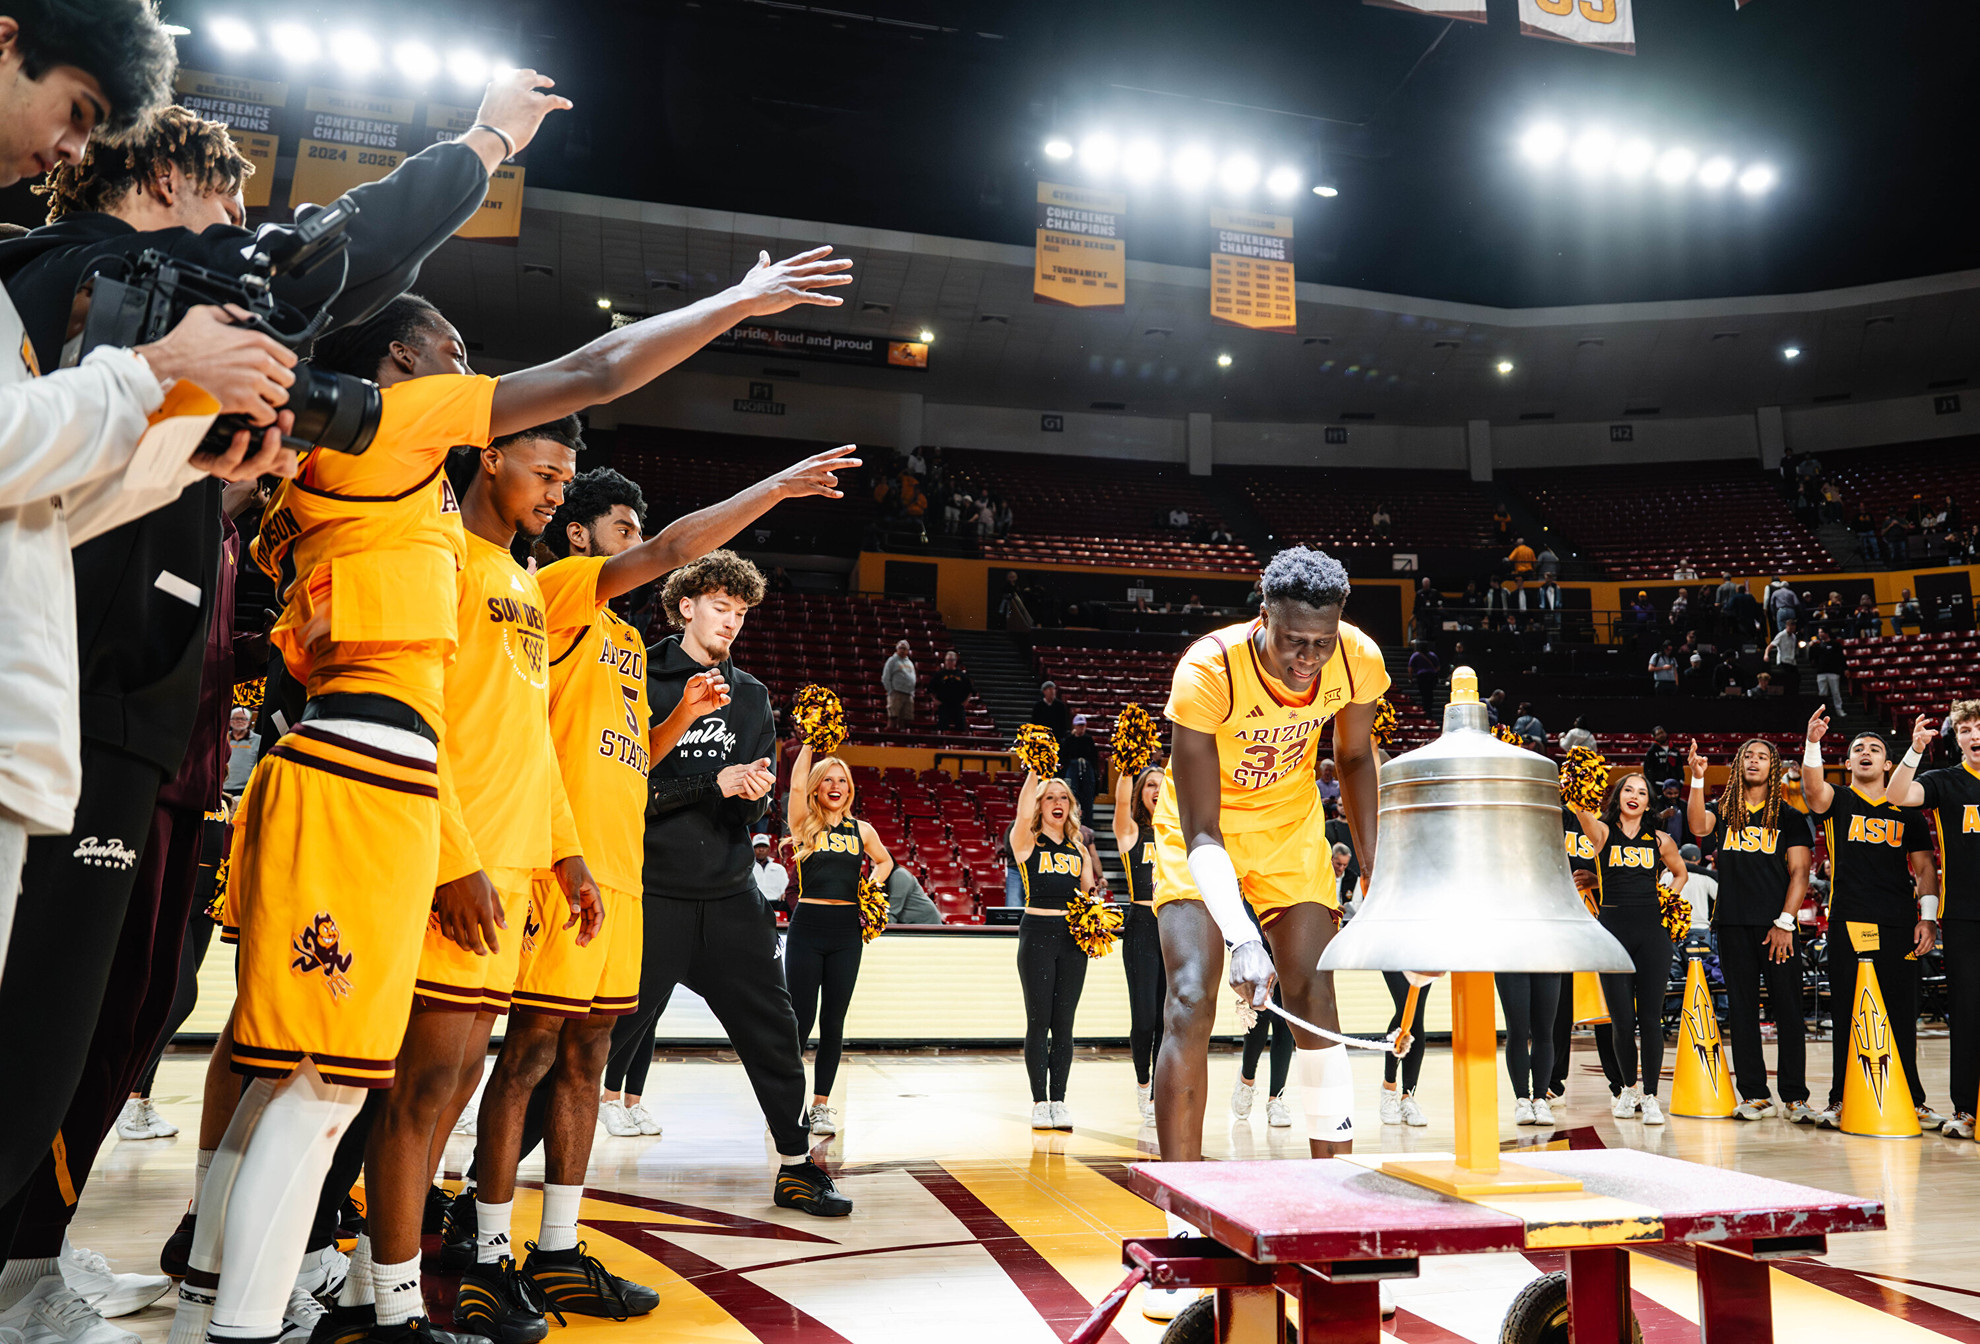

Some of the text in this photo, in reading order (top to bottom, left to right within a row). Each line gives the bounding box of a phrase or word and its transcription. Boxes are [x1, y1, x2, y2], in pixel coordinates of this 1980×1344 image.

[183, 96, 272, 119] CONFERENCE
[315, 114, 399, 136] CONFERENCE
[313, 126, 398, 148] CHAMPIONS
[308, 146, 347, 162] 2024
[358, 152, 397, 168] 2025
[1046, 206, 1116, 225] CONFERENCE
[1045, 218, 1116, 237] CHAMPIONS
[1220, 231, 1285, 249] CONFERENCE
[1220, 242, 1285, 260] CHAMPIONS
[1052, 265, 1107, 279] TOURNAMENT
[734, 327, 772, 342] pride,
[774, 330, 804, 344] loud
[806, 335, 831, 347] and
[834, 338, 873, 351] proud
[753, 386, 770, 398] F1
[737, 402, 782, 414] NORTH
[1043, 417, 1060, 430] G1
[1611, 428, 1630, 439] H2
[487, 597, 523, 624] SUN
[620, 684, 639, 736] 5
[598, 728, 650, 780] STATE
[1722, 826, 1780, 854] ASU
[1847, 814, 1905, 848] ASU
[814, 830, 860, 856] ASU
[1038, 851, 1081, 878] ASU
[1608, 845, 1654, 869] ASU
